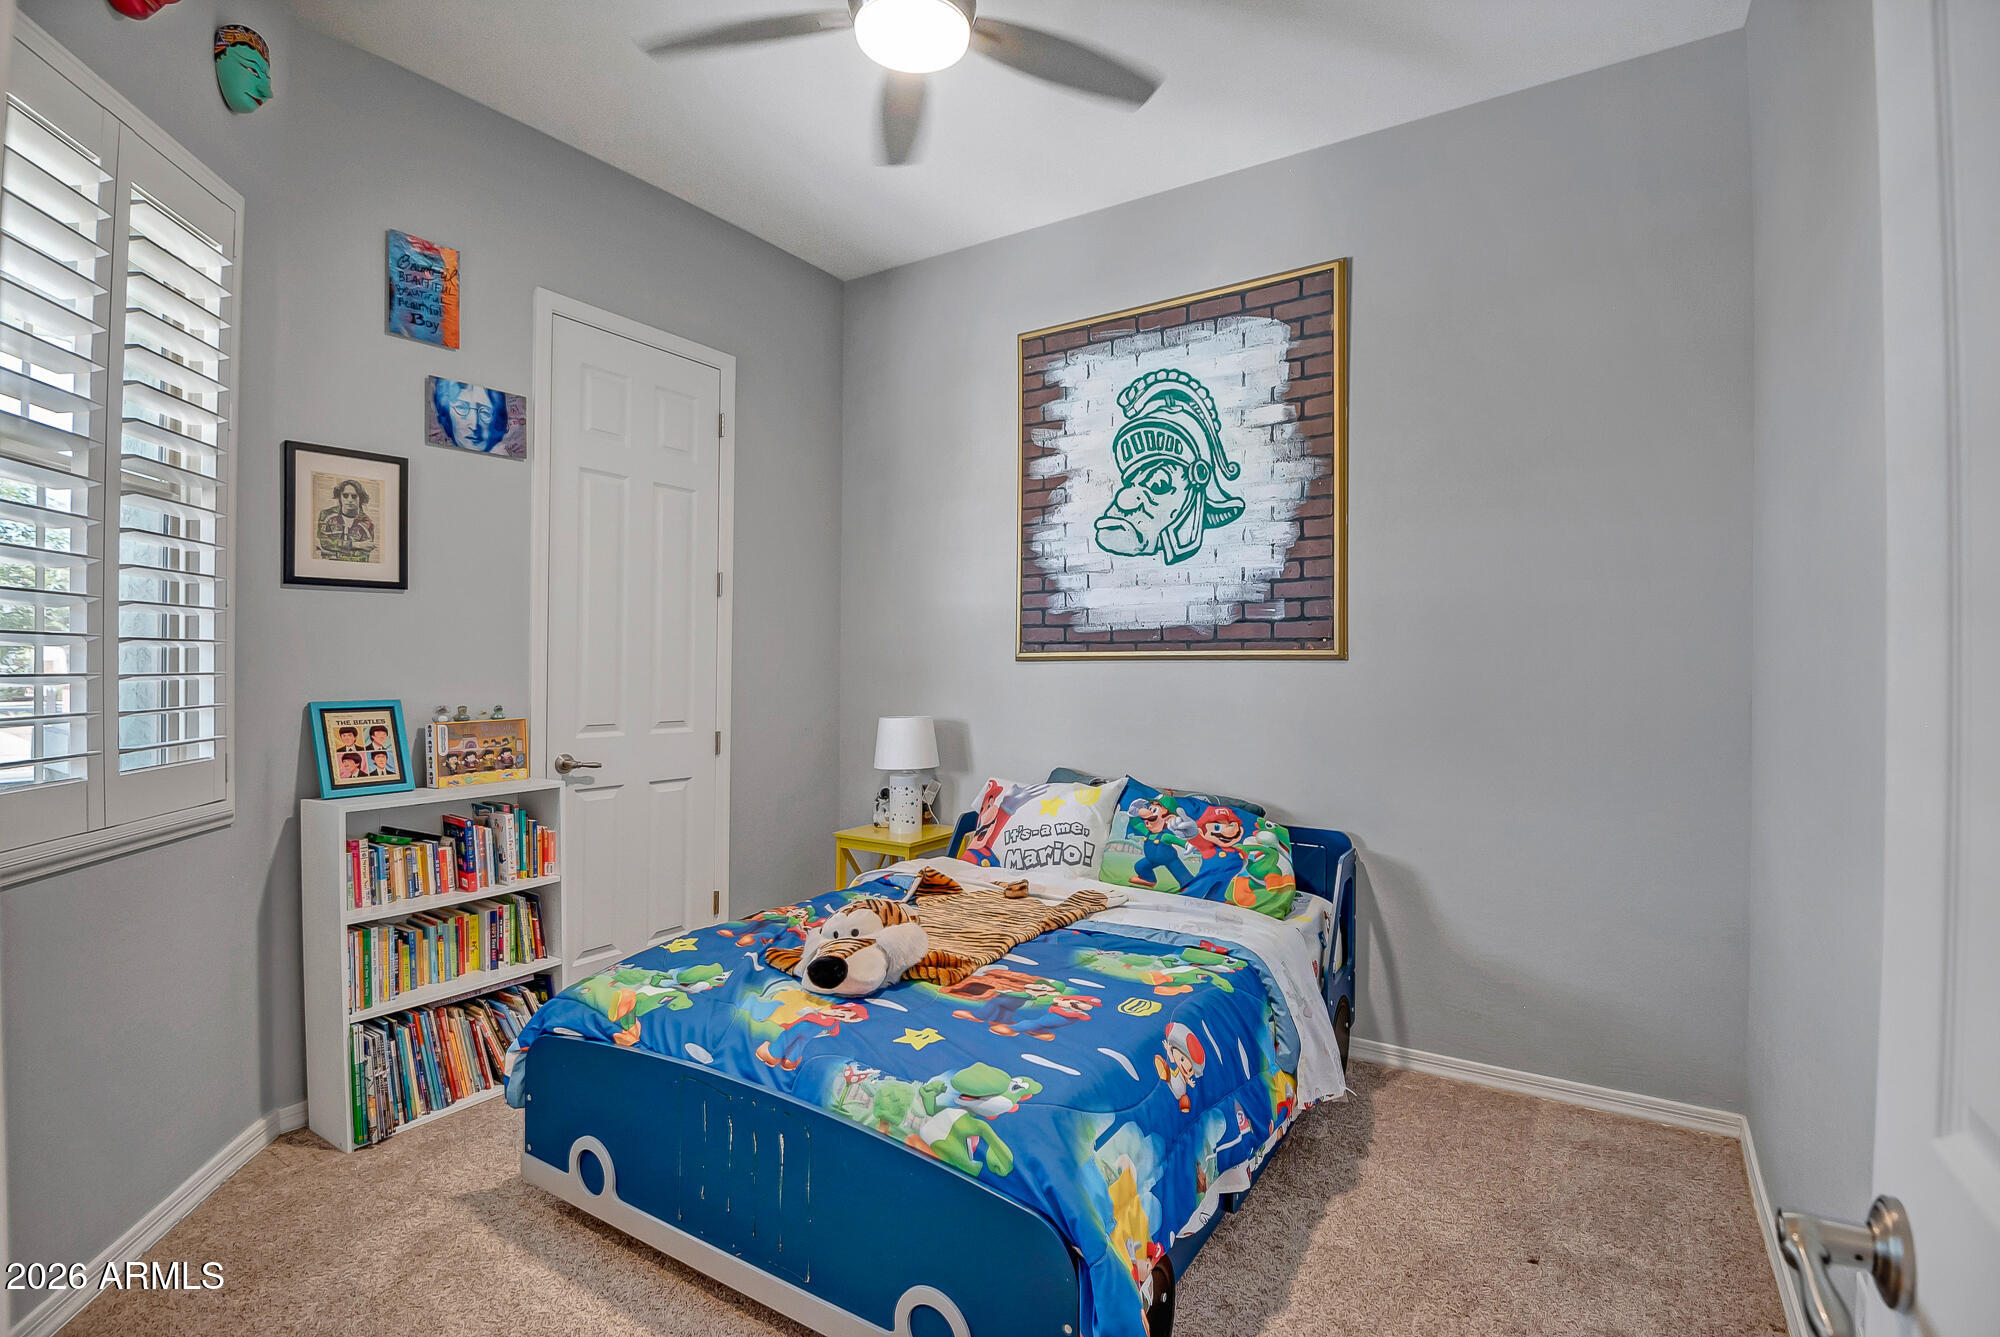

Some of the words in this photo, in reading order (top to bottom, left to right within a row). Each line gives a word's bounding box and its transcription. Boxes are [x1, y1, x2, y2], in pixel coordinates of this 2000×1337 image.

[410, 312, 440, 334] Boy
[1055, 821, 1090, 838] me,
[1004, 840, 1096, 870] Mario!
